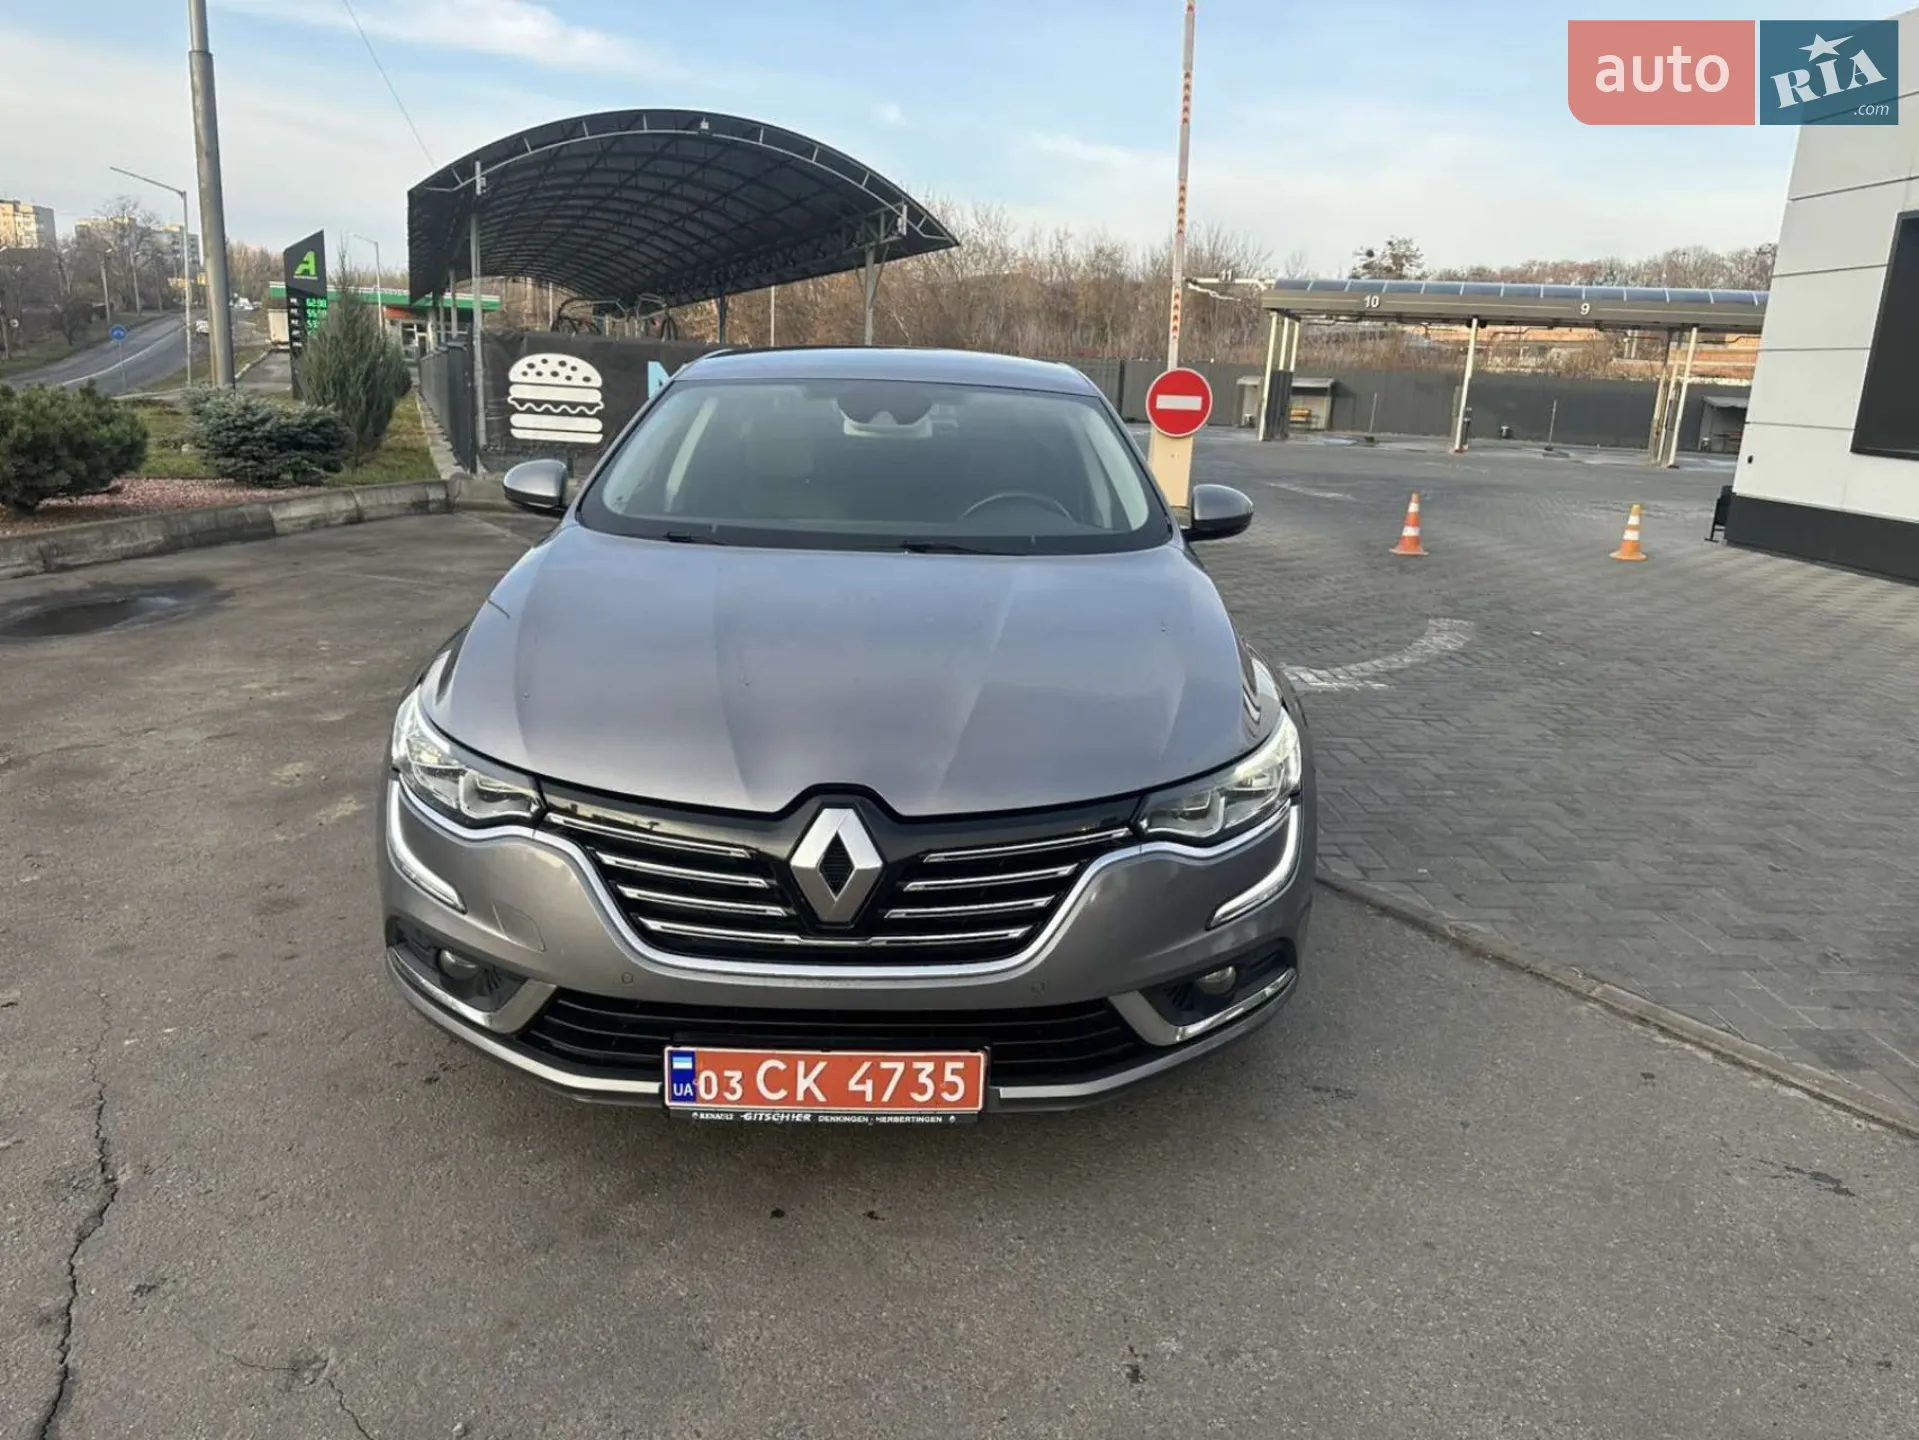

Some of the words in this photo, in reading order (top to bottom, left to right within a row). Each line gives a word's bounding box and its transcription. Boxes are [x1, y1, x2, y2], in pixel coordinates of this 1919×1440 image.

[1363, 294, 1381, 308] 10
[1579, 302, 1591, 316] 9
[698, 1069, 744, 1102] 03
[755, 1058, 829, 1103] CK
[847, 1060, 967, 1103] 4735
[672, 1083, 695, 1097] UA
[741, 1111, 812, 1122] GITSCHIER
